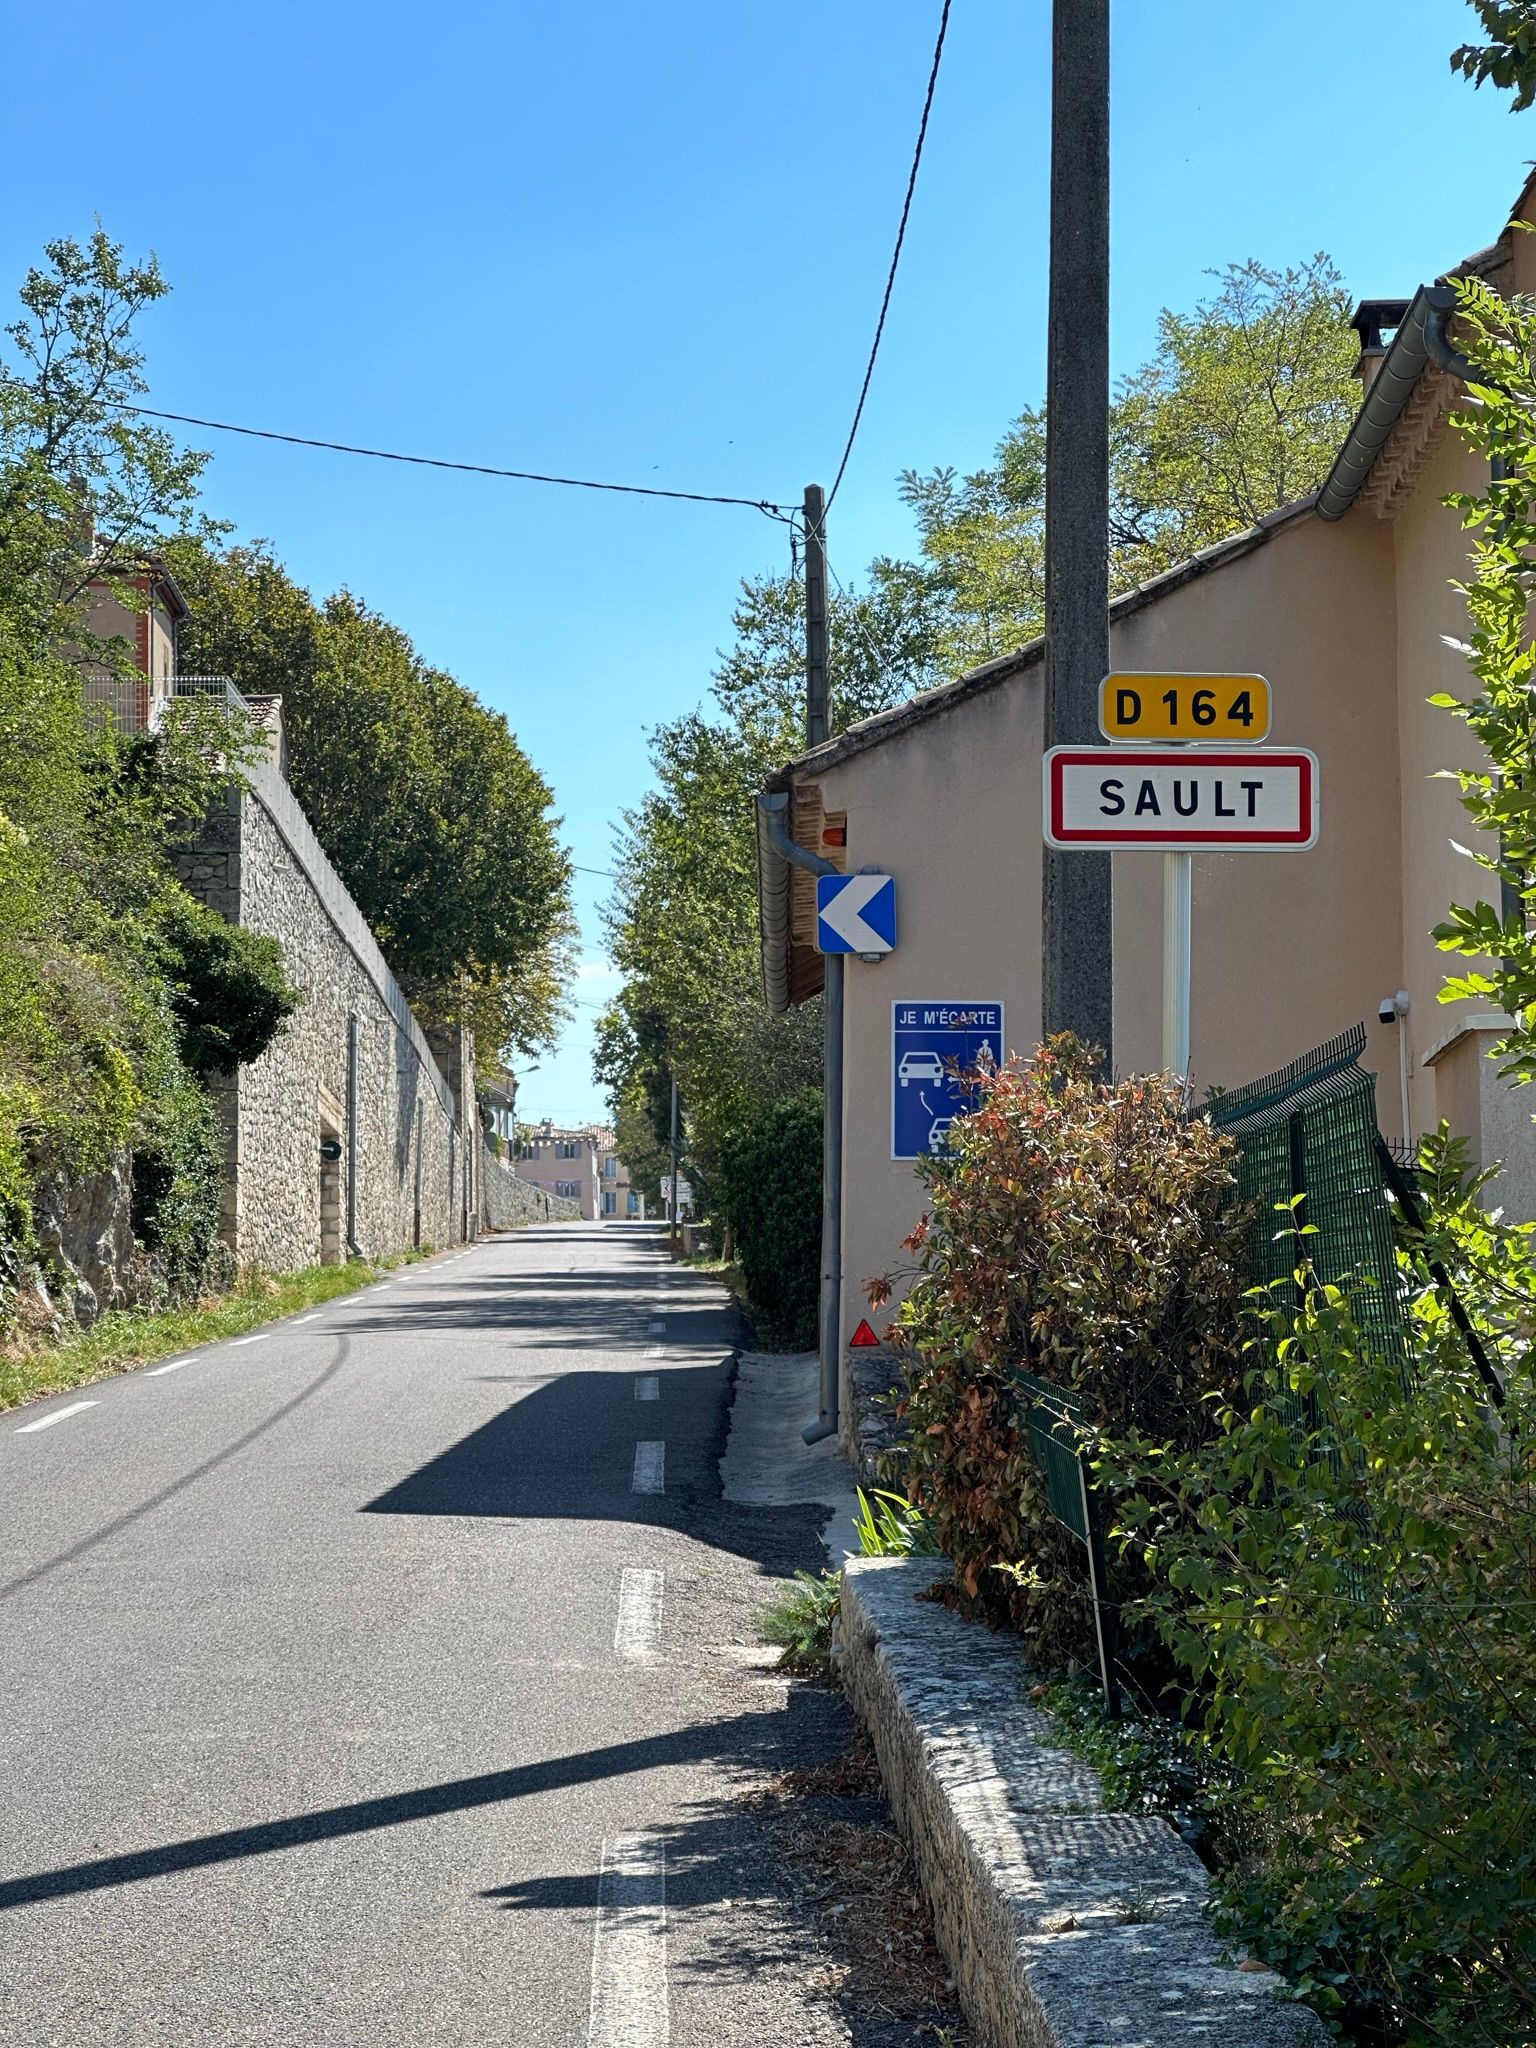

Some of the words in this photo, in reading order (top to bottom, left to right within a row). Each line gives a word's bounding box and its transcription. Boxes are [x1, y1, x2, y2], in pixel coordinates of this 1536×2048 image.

[1116, 688, 1141, 725] D
[1162, 689, 1254, 727] 164
[1099, 778, 1264, 818] SAULT
[899, 1010, 917, 1025] JE
[924, 1007, 996, 1025] M'ÉCARTE
